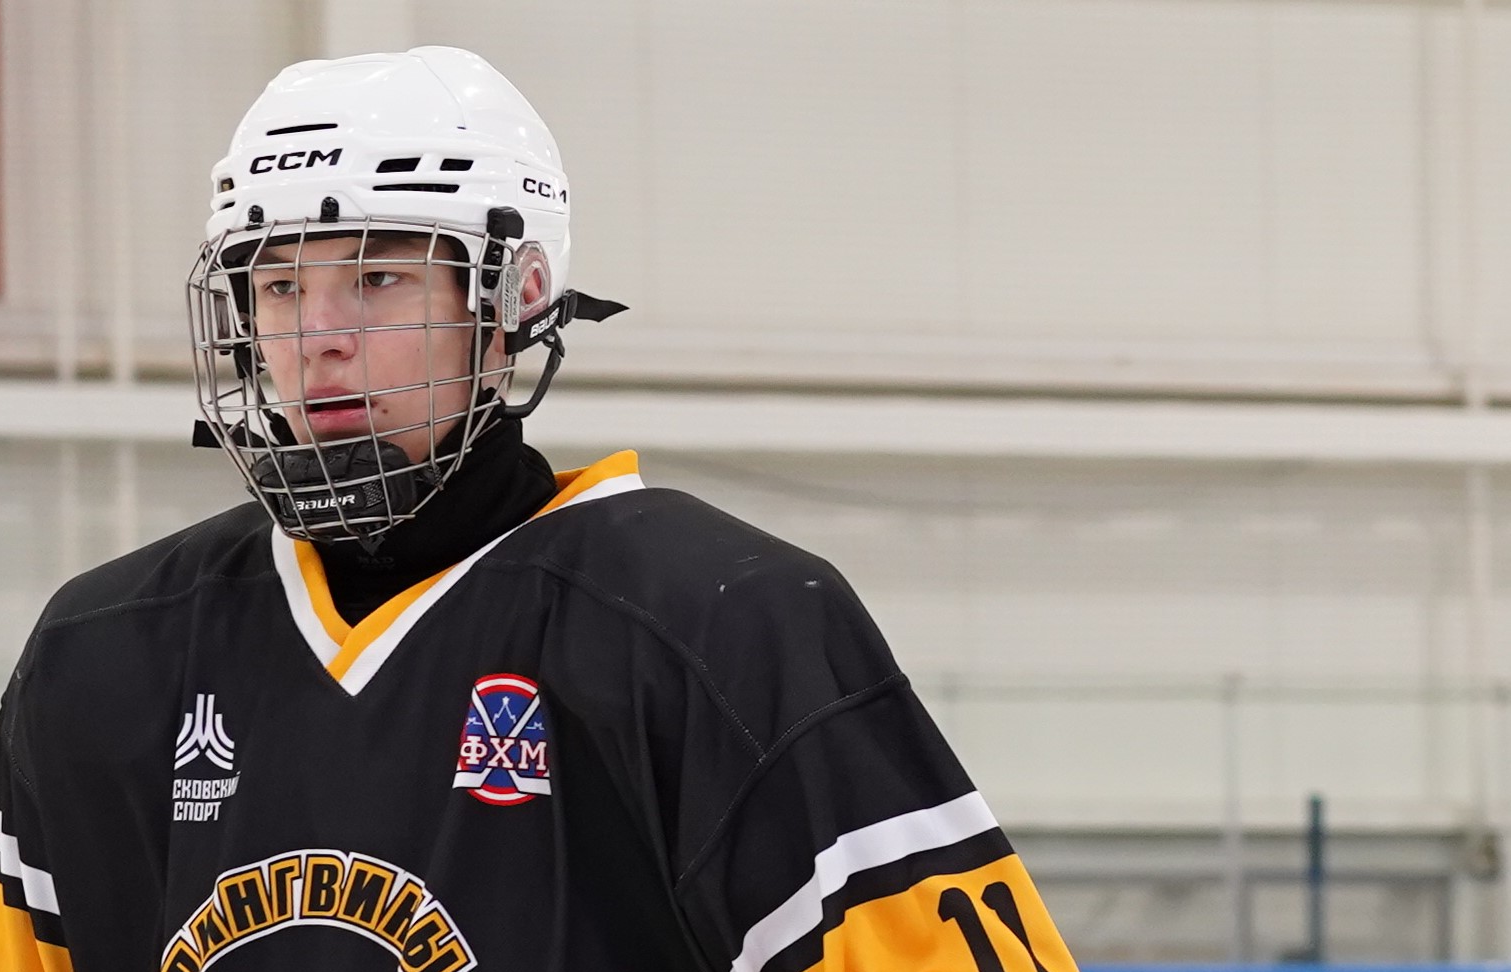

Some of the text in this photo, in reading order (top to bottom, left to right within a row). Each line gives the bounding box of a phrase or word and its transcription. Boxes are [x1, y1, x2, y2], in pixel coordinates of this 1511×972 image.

[249, 147, 344, 175] CCM
[522, 177, 567, 204] CCM
[459, 734, 548, 772] ФХМ
[172, 770, 241, 800] СКОВСКИЙ
[173, 801, 222, 822] СПОРТ
